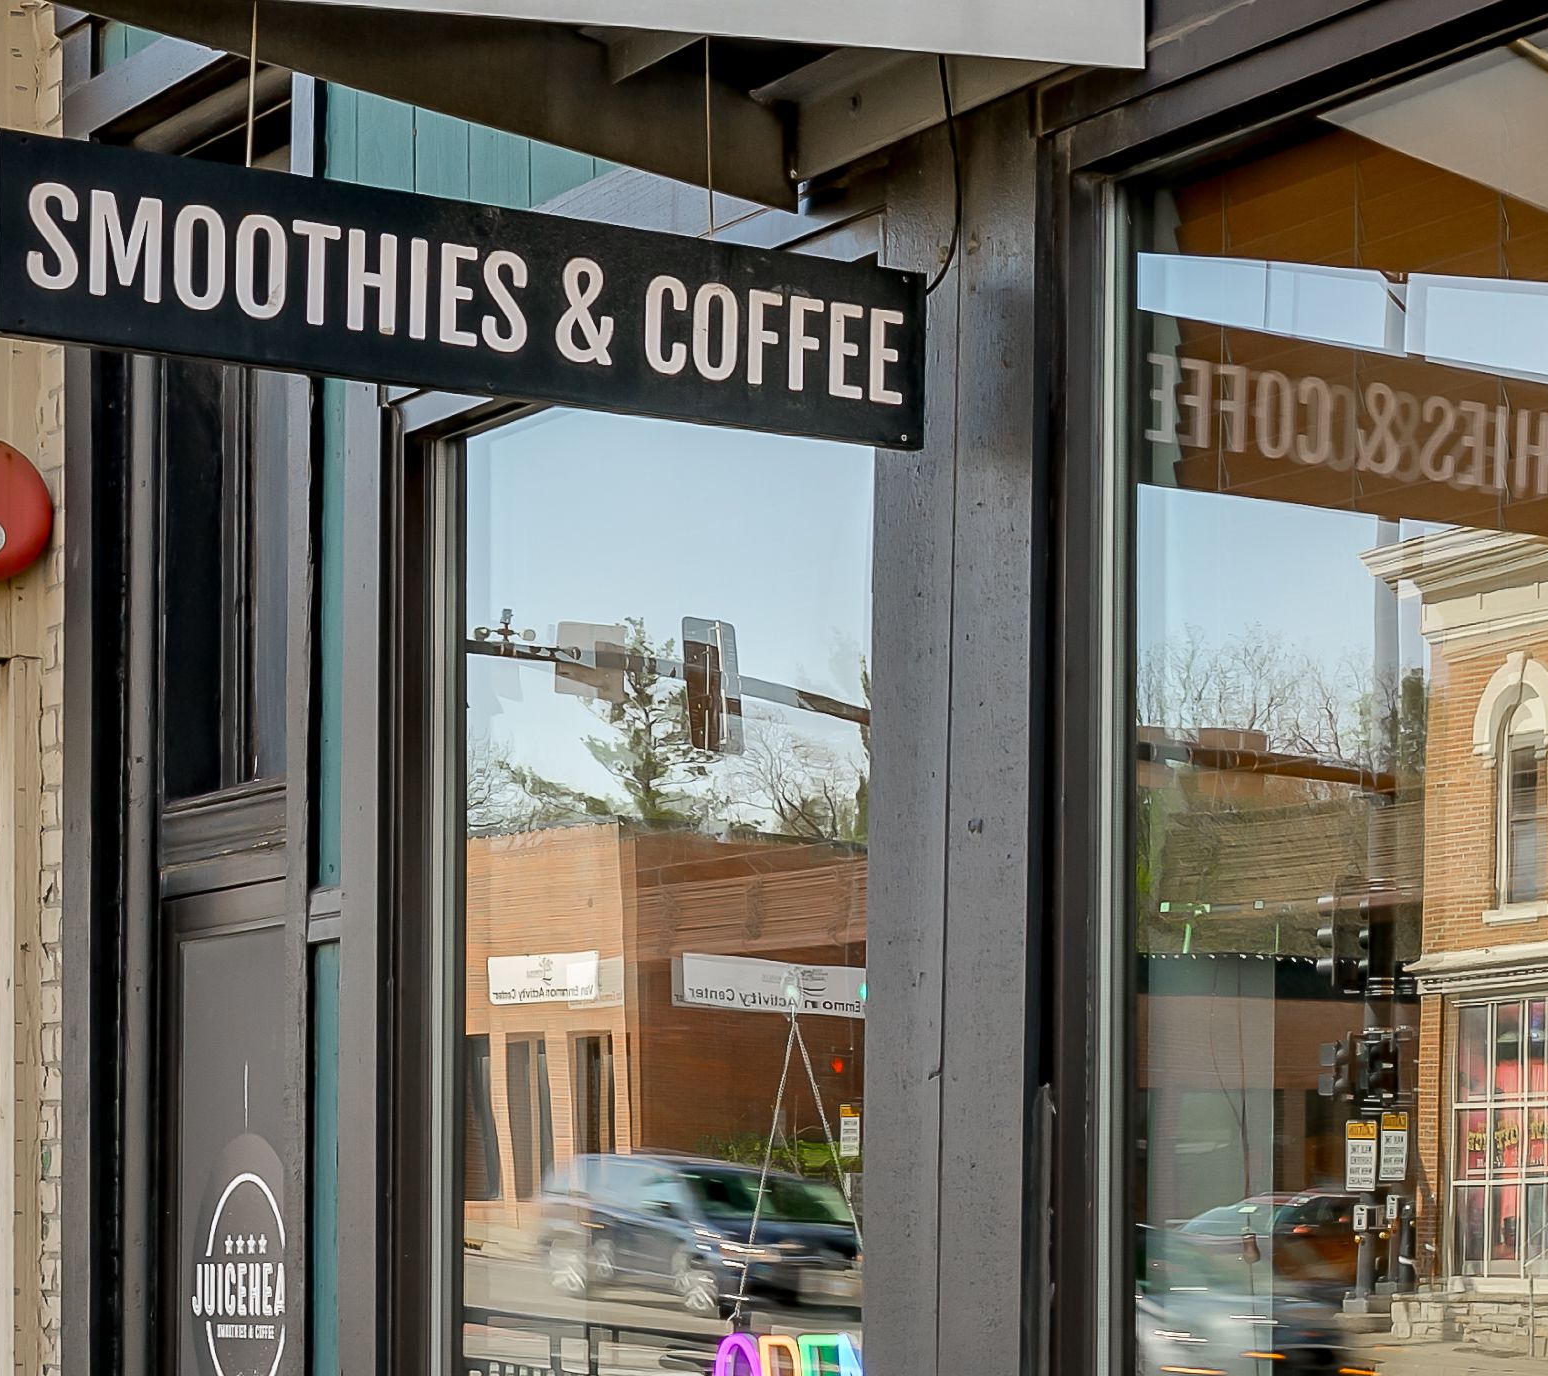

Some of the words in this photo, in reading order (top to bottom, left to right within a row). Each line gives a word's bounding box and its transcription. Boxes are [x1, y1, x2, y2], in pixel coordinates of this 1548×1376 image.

[26, 182, 528, 355] SMOOTHIES
[555, 257, 614, 366] &
[644, 274, 903, 406] COFFEE
[192, 1262, 286, 1317] JUICEHEA
